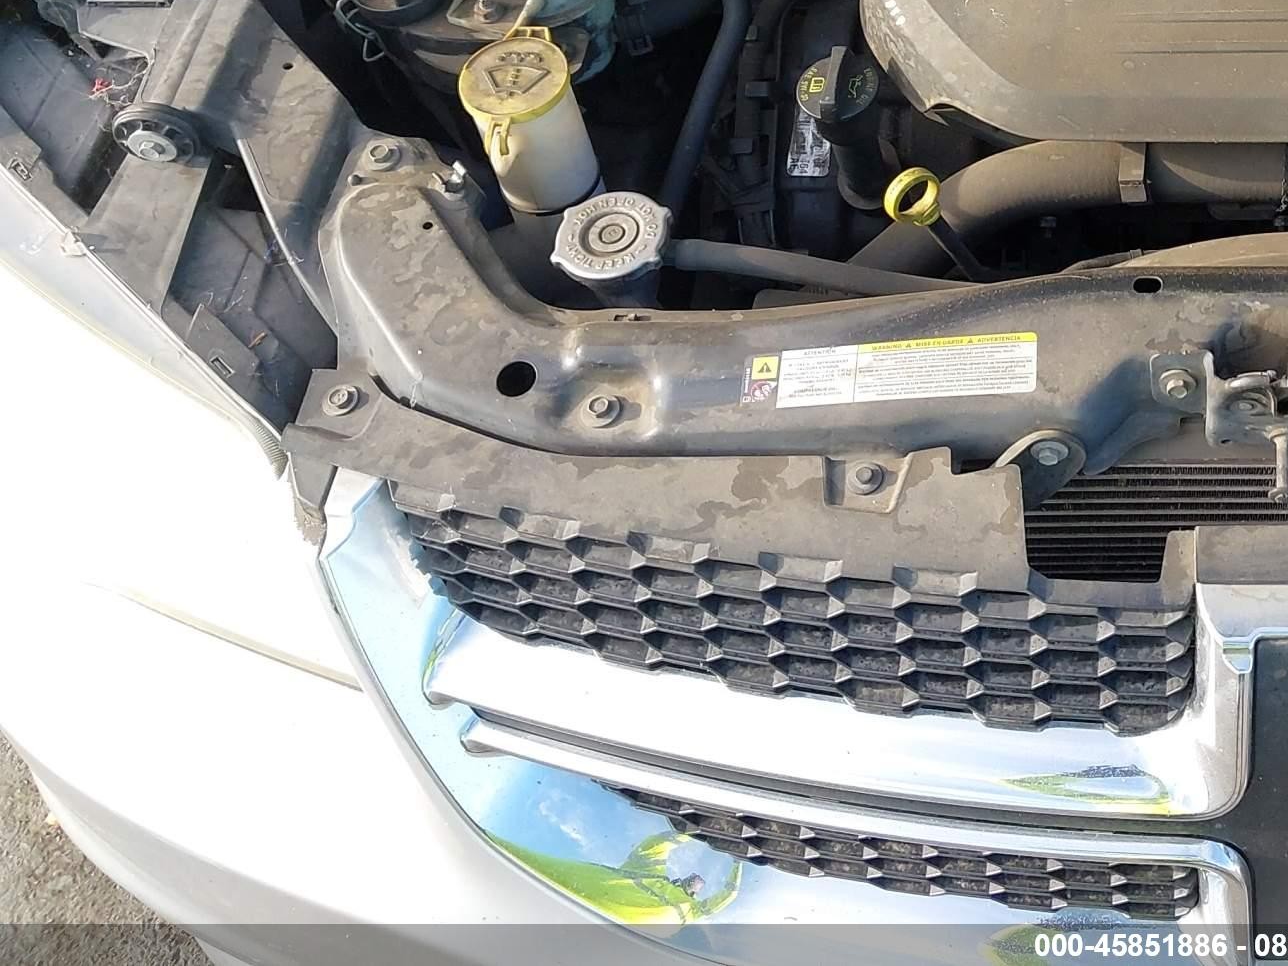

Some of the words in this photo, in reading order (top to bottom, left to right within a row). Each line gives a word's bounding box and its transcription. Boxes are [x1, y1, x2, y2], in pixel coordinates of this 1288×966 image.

[599, 196, 635, 209] OPEN
[574, 204, 598, 226] HOT
[597, 252, 636, 270] KEEP
